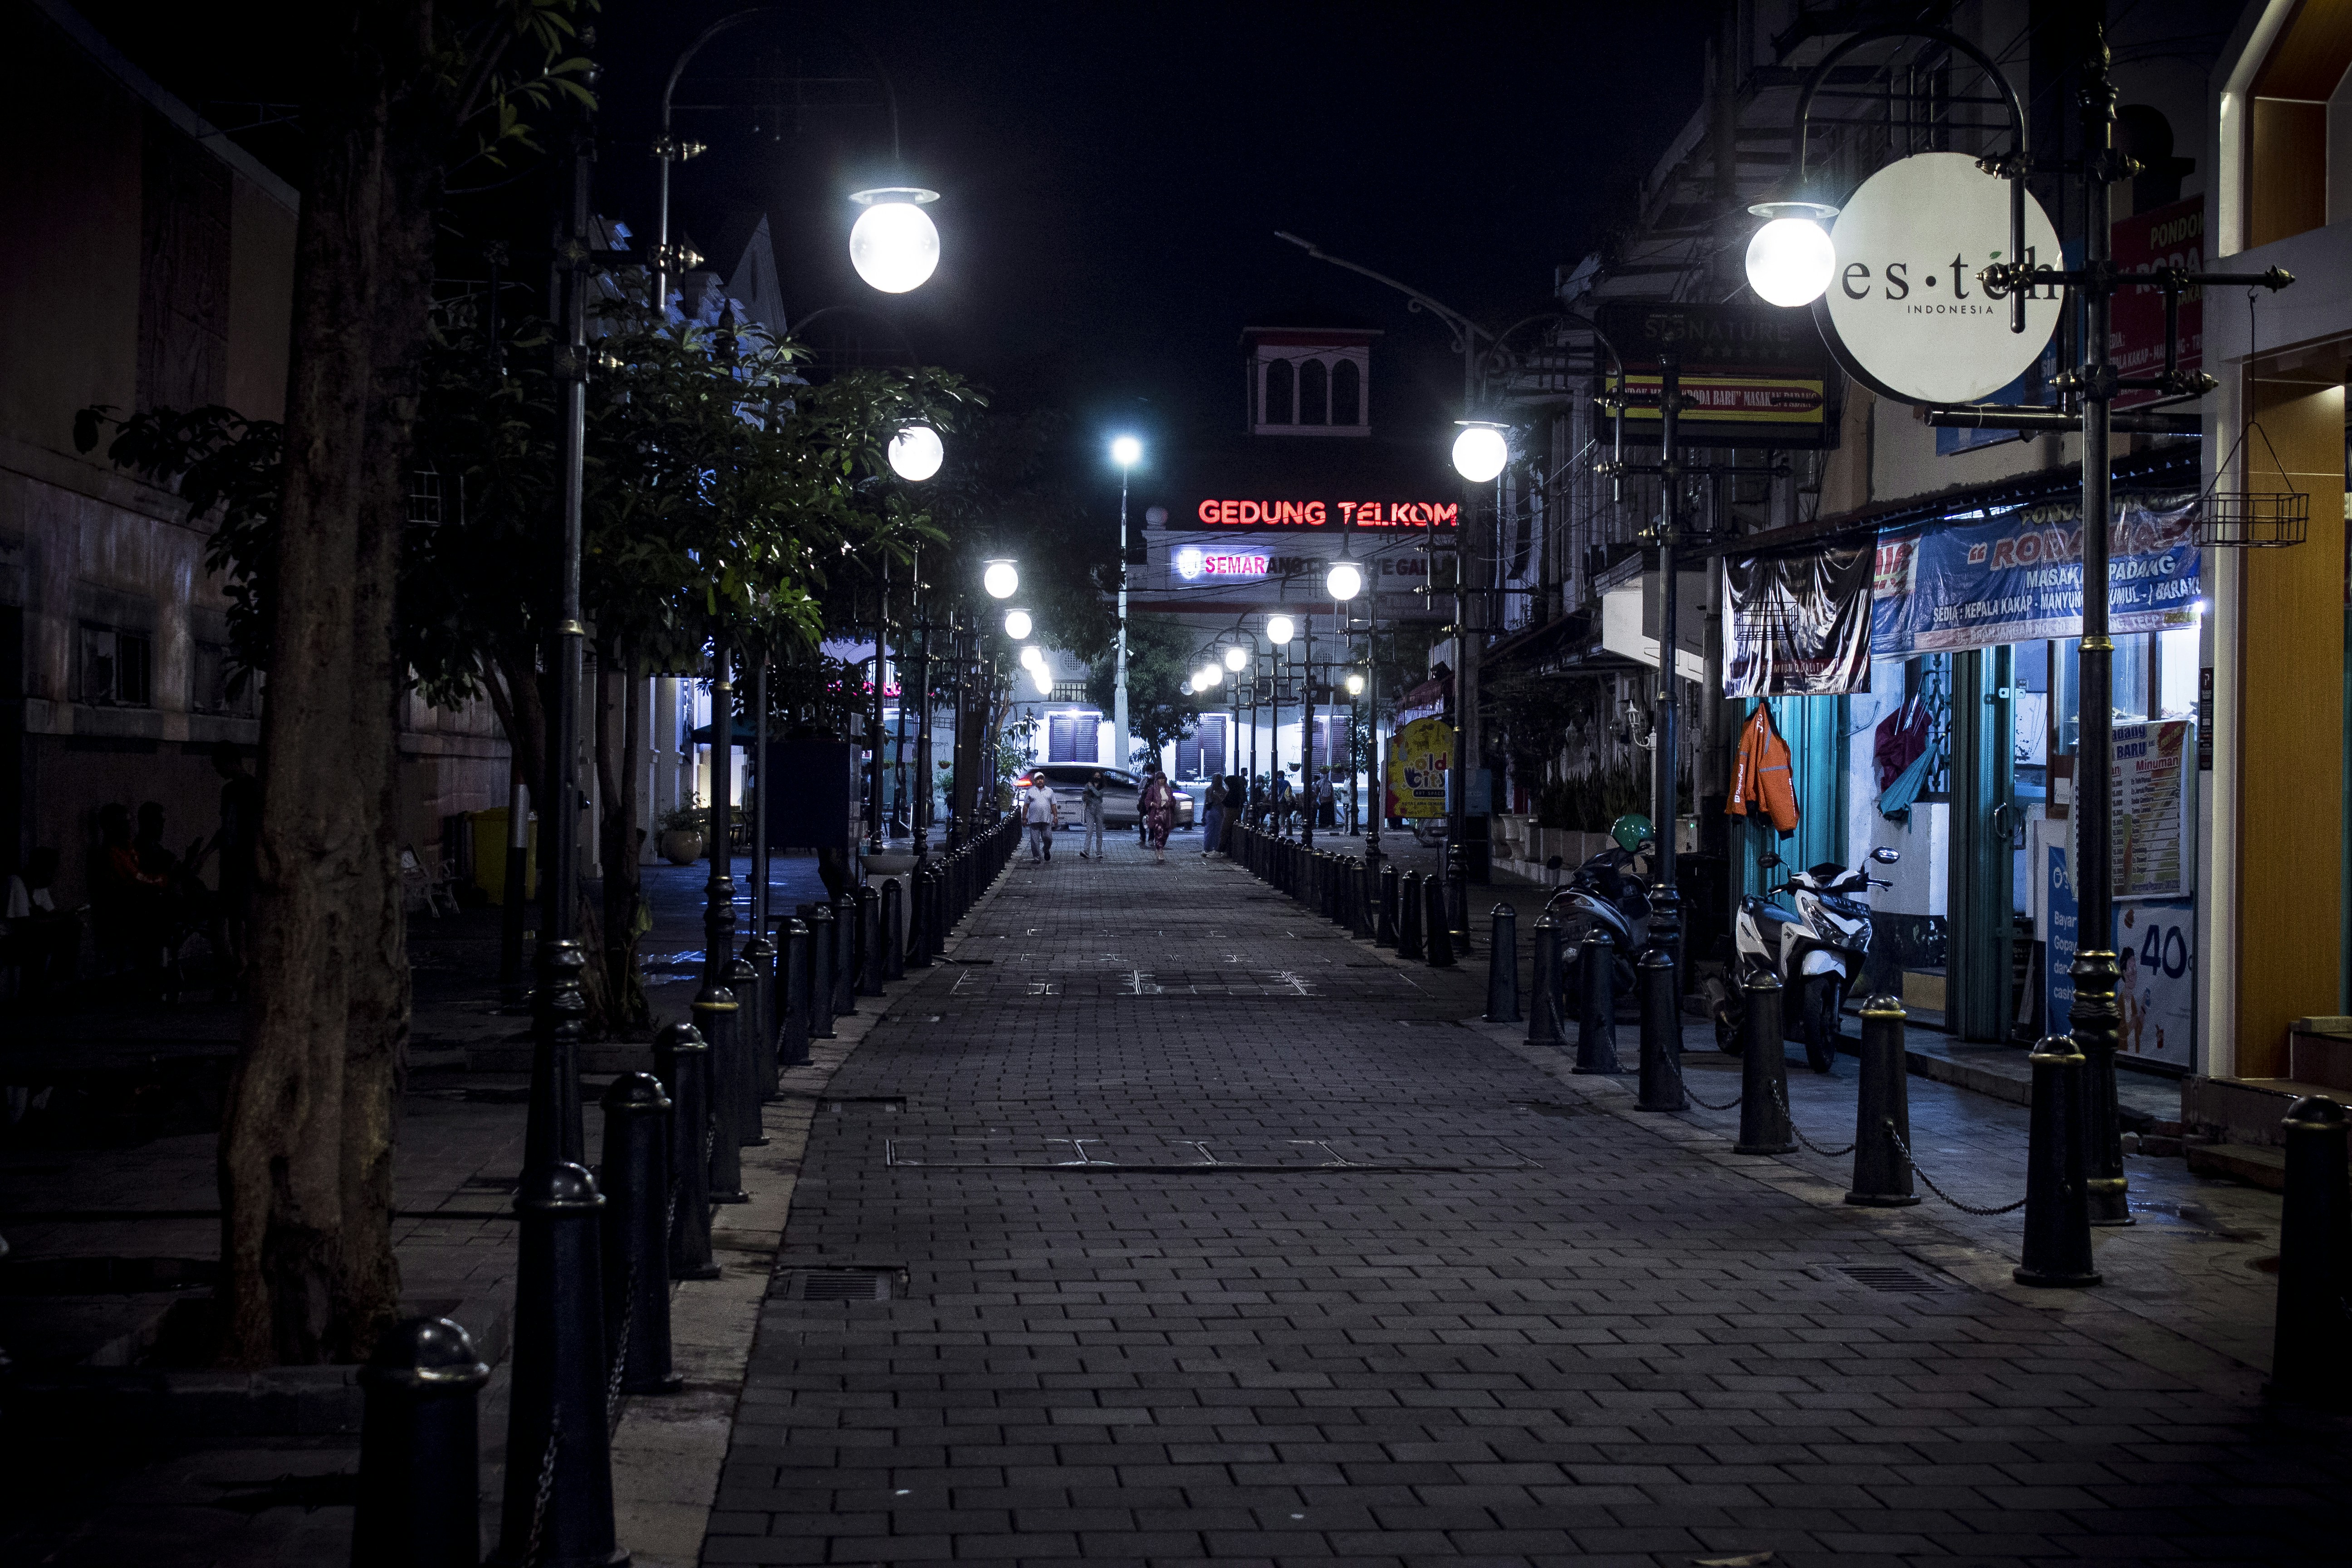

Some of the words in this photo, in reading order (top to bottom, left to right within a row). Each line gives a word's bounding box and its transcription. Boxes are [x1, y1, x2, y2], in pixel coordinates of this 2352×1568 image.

[1907, 305, 1993, 314] INDONESIA
[1645, 318, 1790, 343] SIGNATURE
[1199, 500, 1326, 525] GEDUNG
[1338, 501, 1457, 527] TELKOM
[2109, 555, 2176, 581] PADANG
[1965, 599, 1999, 618] KEPALA
[2001, 595, 2033, 614] KAKAP
[2041, 589, 2083, 610] MANYUN
[2112, 725, 2146, 739] adang
[1415, 752, 1446, 771] old
[2136, 756, 2179, 774] Minuman
[2054, 911, 2077, 931] Bayar
